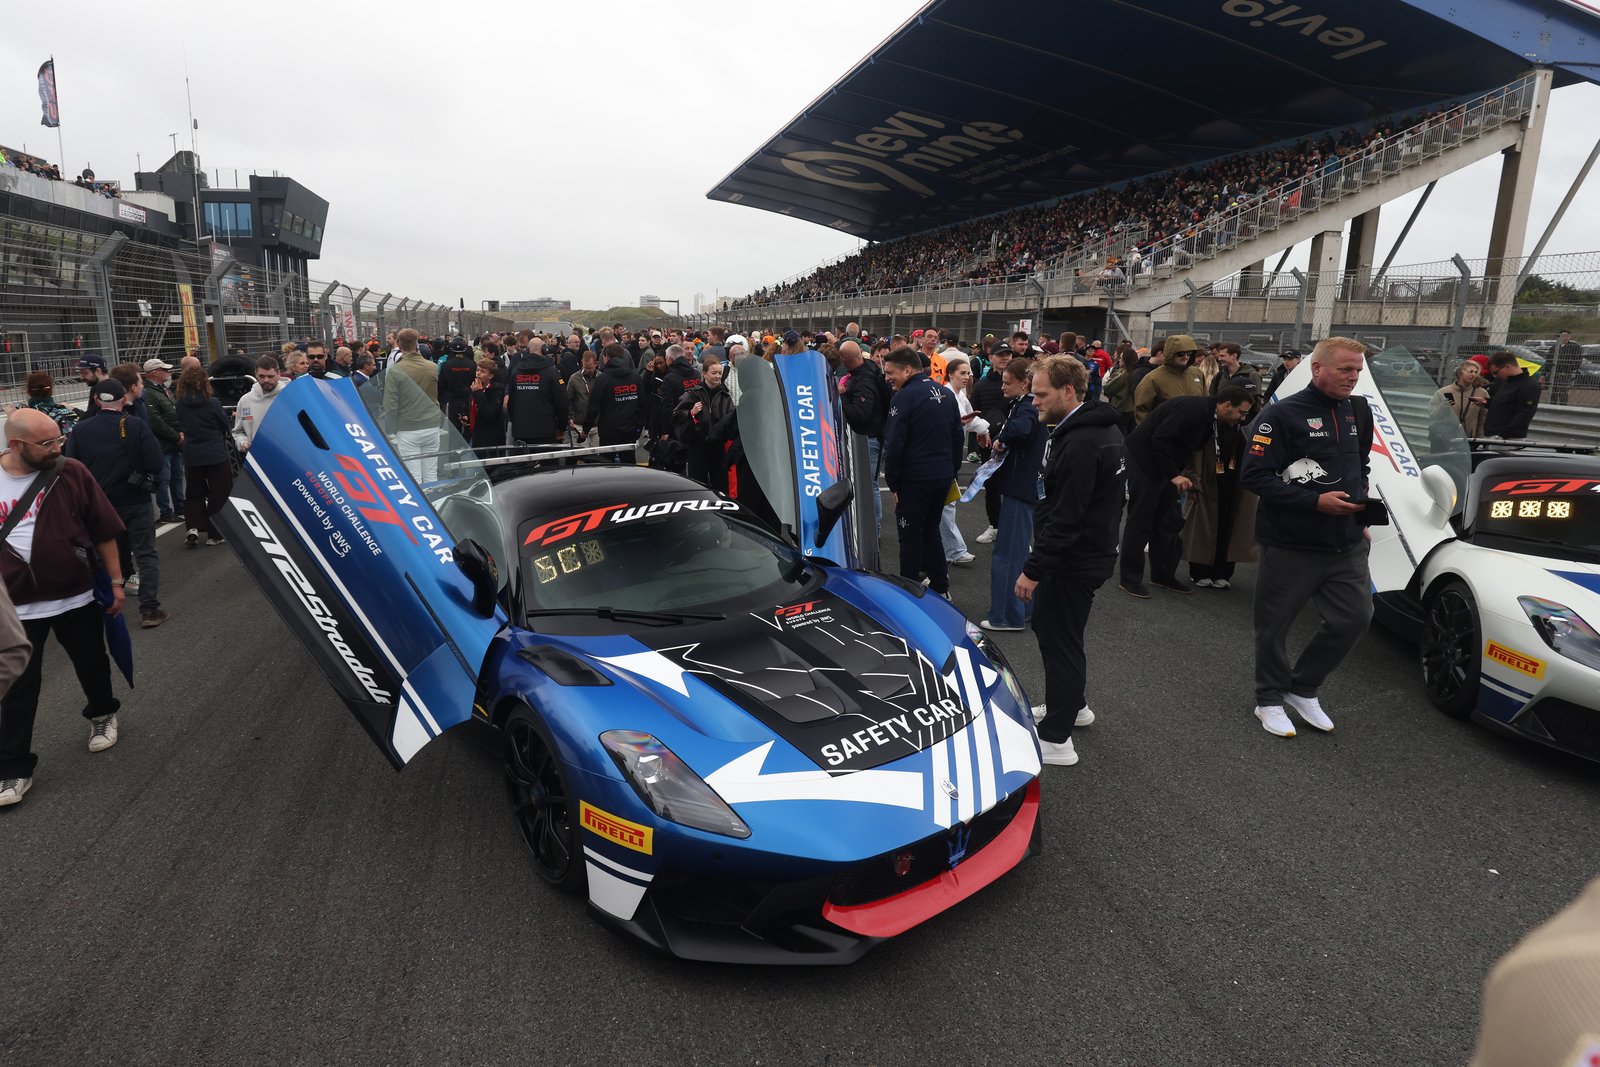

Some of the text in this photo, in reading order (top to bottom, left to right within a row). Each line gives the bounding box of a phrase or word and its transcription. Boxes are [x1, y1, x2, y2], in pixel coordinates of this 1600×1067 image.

[515, 373, 541, 383] SRO
[614, 383, 638, 394] SRO
[797, 384, 822, 497] SAFETY CAR
[1389, 441, 1419, 477] CAR
[304, 470, 333, 506] EUROPE
[332, 454, 420, 546] GT
[345, 423, 454, 565] SAFETY CAR
[1489, 479, 1600, 495] GT
[292, 478, 352, 555] powered by aws
[317, 471, 382, 556] WORLD CHALLENGE
[524, 499, 740, 547] GT WORLD
[775, 600, 823, 617] GT
[785, 608, 832, 621] WORLD CHALLENGE
[785, 617, 806, 625] EUROPE
[791, 619, 814, 630] powered
[1488, 644, 1540, 675] PIRELLI
[821, 699, 962, 766] SAFETY CAR
[585, 808, 645, 848] PIRELLI
